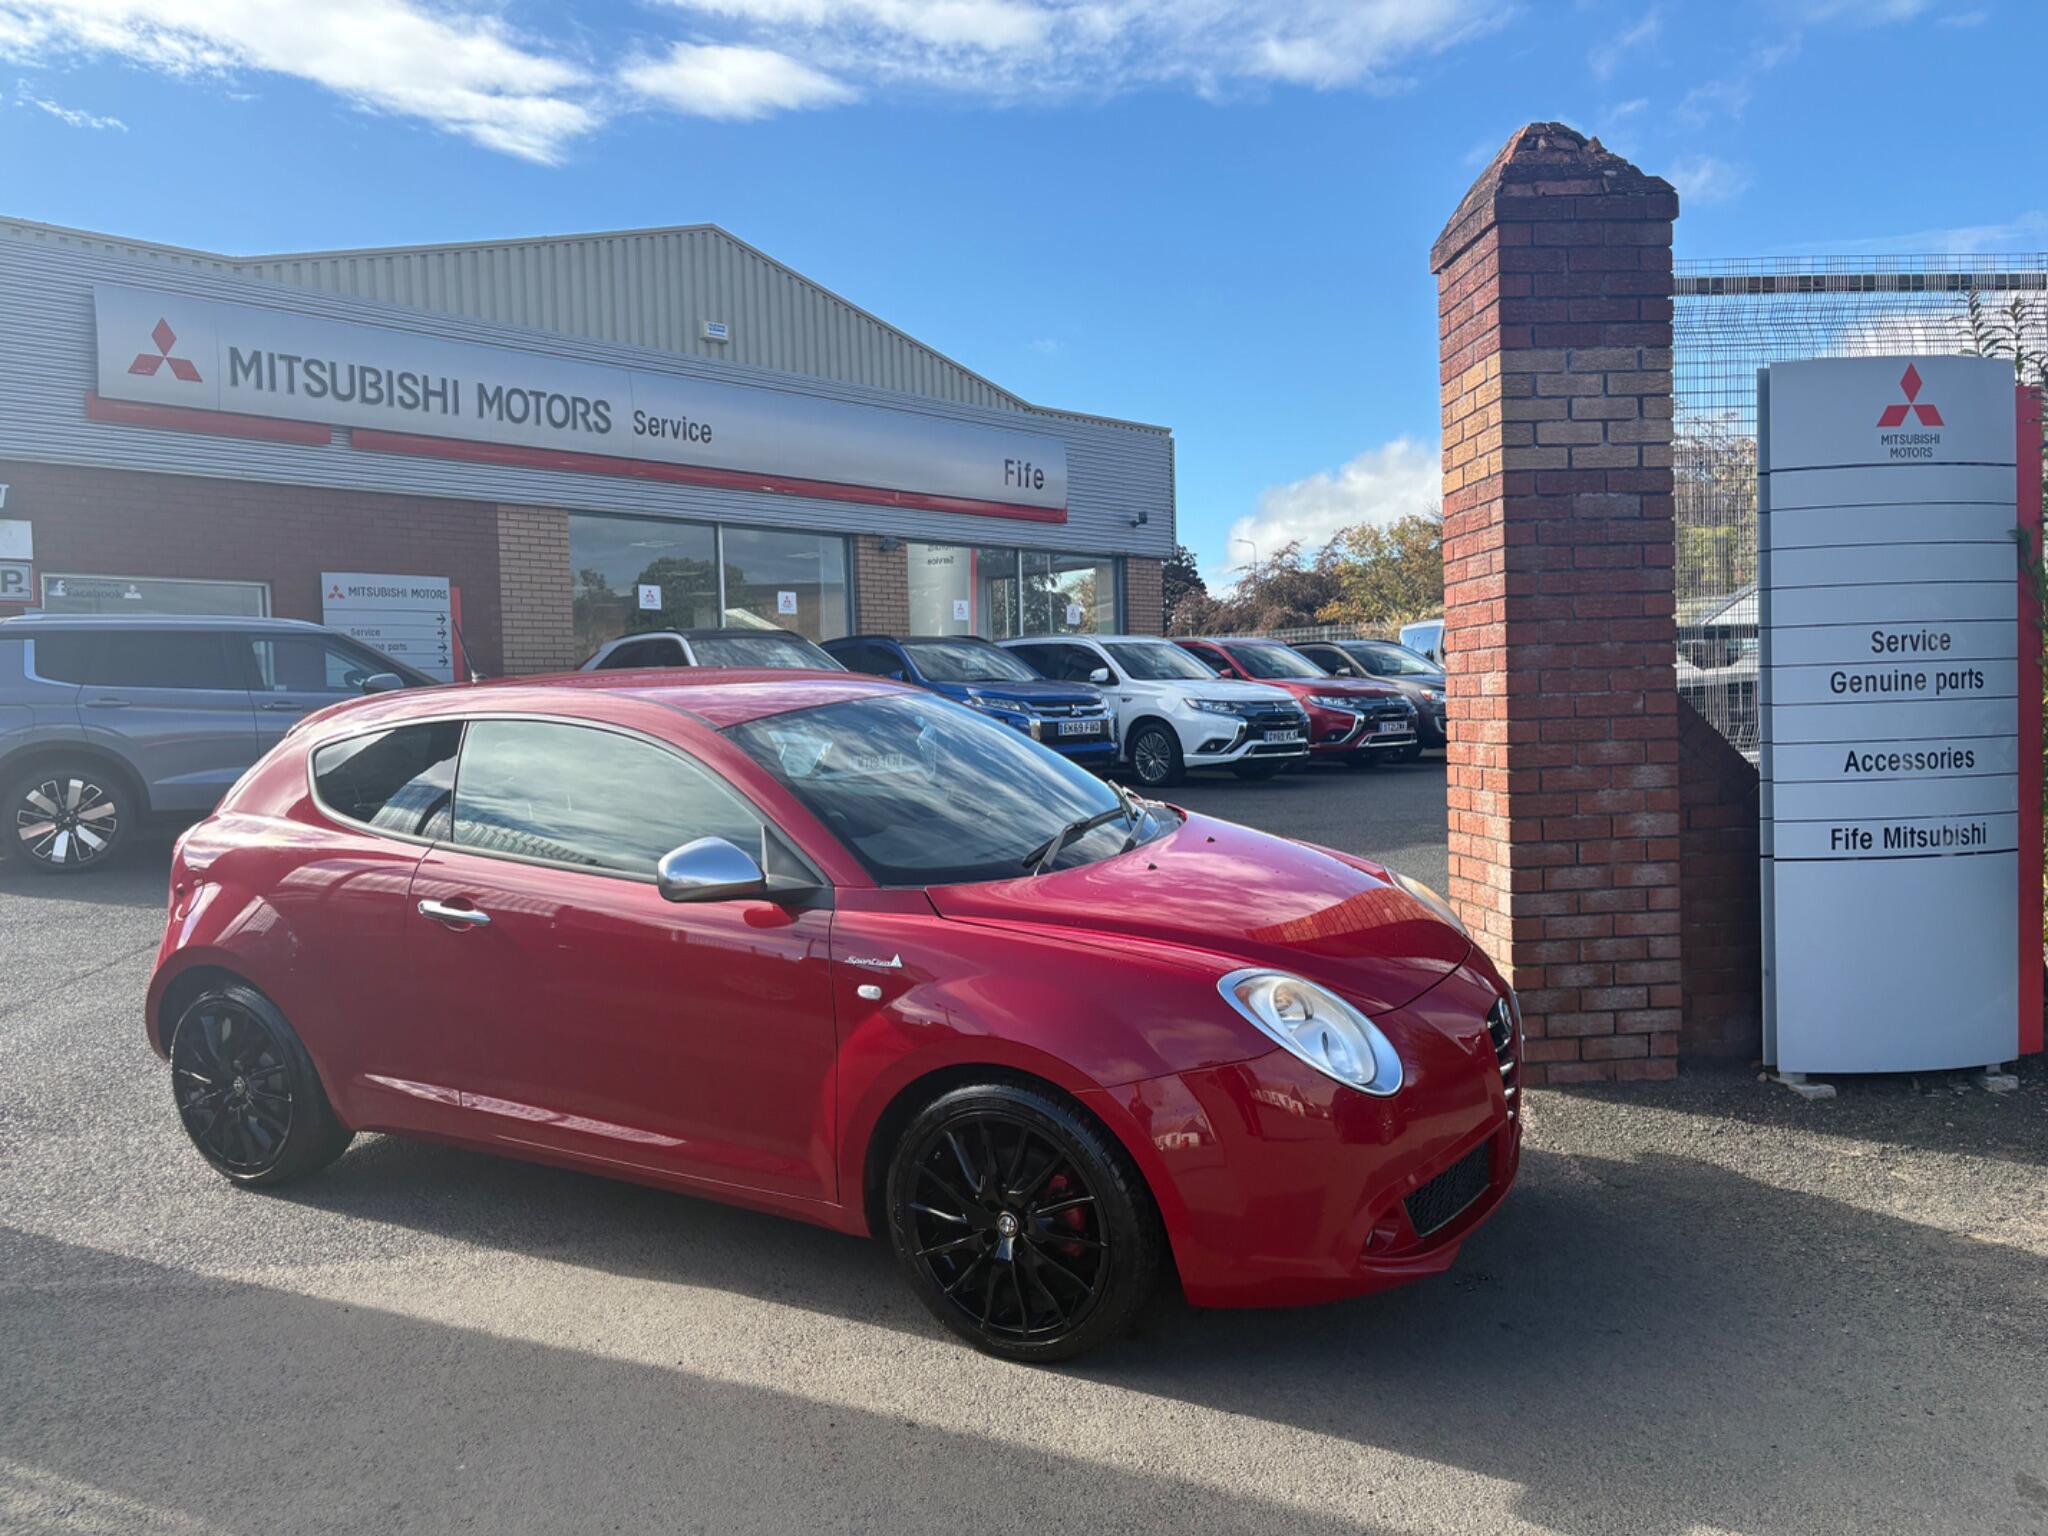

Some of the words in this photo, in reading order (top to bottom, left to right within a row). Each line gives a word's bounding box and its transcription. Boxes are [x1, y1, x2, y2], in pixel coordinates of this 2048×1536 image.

[229, 346, 460, 416] MITSUBISHI
[477, 383, 612, 433] MOTORS
[633, 410, 713, 444] Service
[1880, 433, 1941, 447] MITSUBISHI
[1889, 446, 1934, 459] MOTORS
[1004, 459, 1045, 491] Fife
[348, 586, 408, 598] MITSUBISHI
[411, 588, 448, 600] MOTORS
[350, 627, 381, 637] Service
[1871, 630, 1952, 655] Service
[1831, 670, 1926, 695] Genuine
[1935, 667, 1985, 695] parts
[1844, 747, 1975, 774] Accessories
[1831, 826, 1873, 851] Fife
[1883, 823, 1987, 850] Mitsubishi
